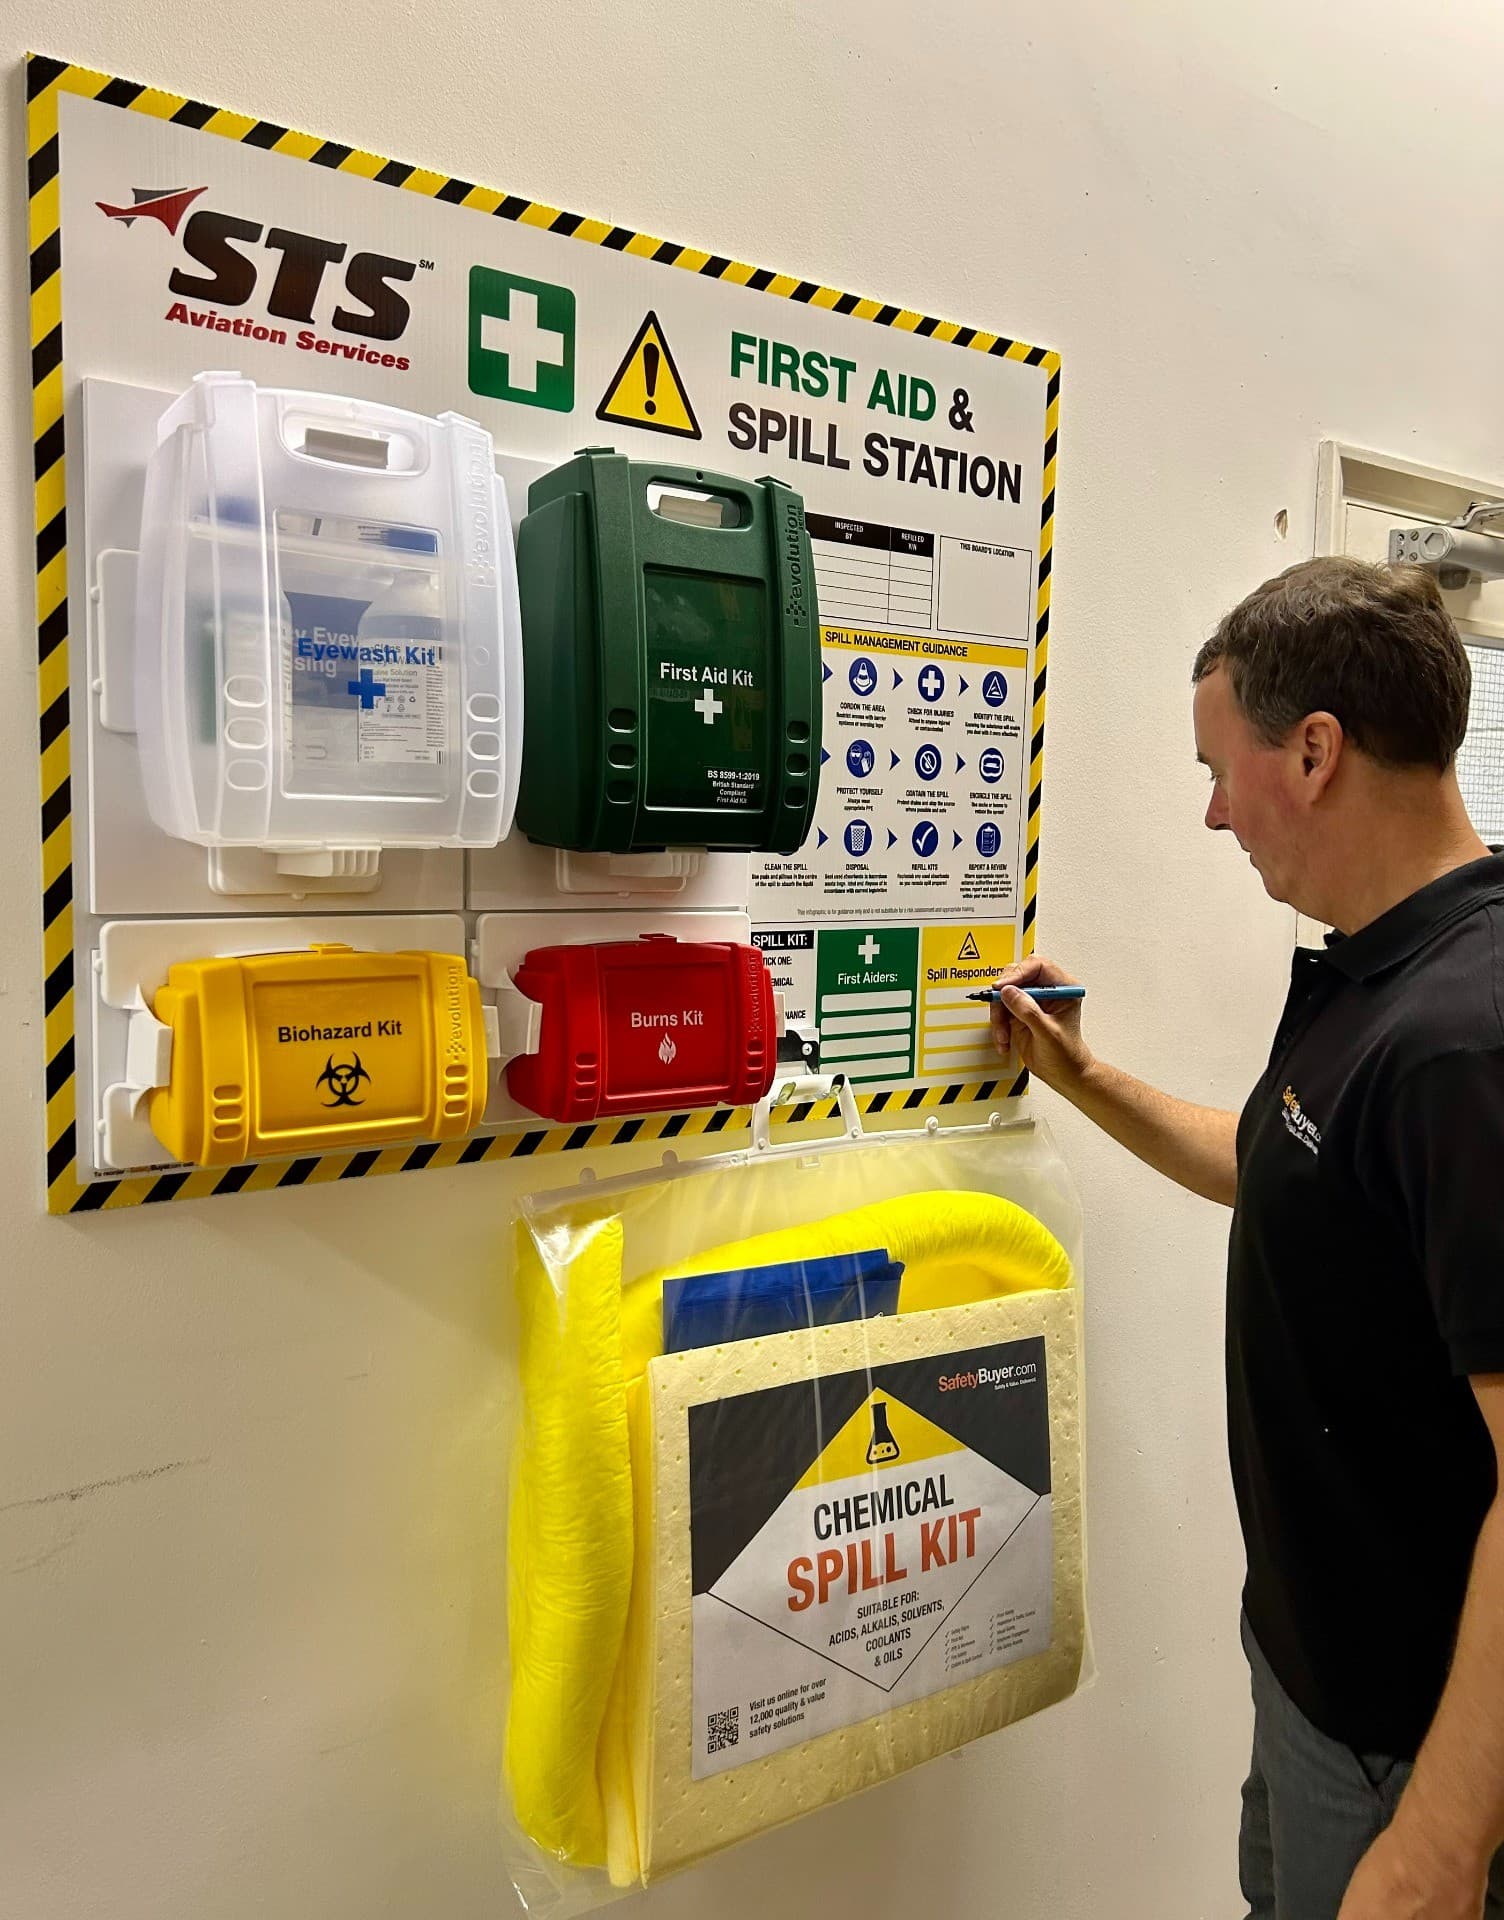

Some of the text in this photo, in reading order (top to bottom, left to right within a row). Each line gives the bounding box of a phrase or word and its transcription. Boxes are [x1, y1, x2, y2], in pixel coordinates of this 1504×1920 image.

[168, 210, 417, 341] STS
[165, 302, 411, 371] Aviation Services
[731, 331, 975, 433] FIRST AID &
[728, 402, 1022, 504] SPILL STATION
[834, 521, 864, 533] INSPECTED
[845, 533, 853, 541] BY
[901, 532, 925, 543] REFILLED
[785, 504, 803, 600] evolution
[960, 543, 1015, 558] THIS BOARD'S LOCATION
[297, 638, 398, 664] Eyewash
[405, 645, 435, 666] Kit
[825, 631, 968, 657] SPILL MANAGEMENT GUIDANCE
[660, 661, 754, 687] First Aid Kit
[840, 702, 886, 712] CORDON THE AREA
[907, 707, 922, 715] CHECK
[974, 712, 993, 720] IDENTIFY
[1002, 714, 1015, 722] SPILL
[707, 770, 760, 780] BS 8599-1:2019
[712, 780, 730, 788] British
[720, 788, 746, 796] Compliant
[836, 787, 884, 796] PROTECT YOURSELF
[905, 790, 950, 798] CONTAIN THE SPILL
[991, 792, 1000, 800] THE
[764, 863, 808, 871] CLEAN THE SPILL
[846, 863, 870, 871] DISPOSAL
[752, 933, 808, 947] SPILL KIT:
[778, 956, 792, 966] ONE:
[771, 977, 794, 987] EMICAL
[838, 971, 898, 985] First Aiders:
[927, 966, 1004, 982] Spill Responder
[447, 966, 462, 1040] evolution
[631, 1010, 704, 1028] Burns Kit
[785, 1010, 806, 1020] NANCE
[278, 1019, 402, 1043] Biohazard Kit
[938, 1362, 1037, 1392] SafetyBuyer.com
[813, 1474, 954, 1541] CHEMICAL
[787, 1507, 981, 1612] SPILL KIT
[857, 1590, 920, 1619] SUITABLE FOR:
[828, 1599, 945, 1647] ACIDS, ALKALIS, SOLVENTS,
[865, 1627, 911, 1652] COOLANTS
[874, 1647, 903, 1667] & OILS
[749, 1678, 827, 1711] Visit us online for over
[750, 1691, 826, 1725] 12,000 quality & value
[749, 1712, 805, 1738] safety solutions
